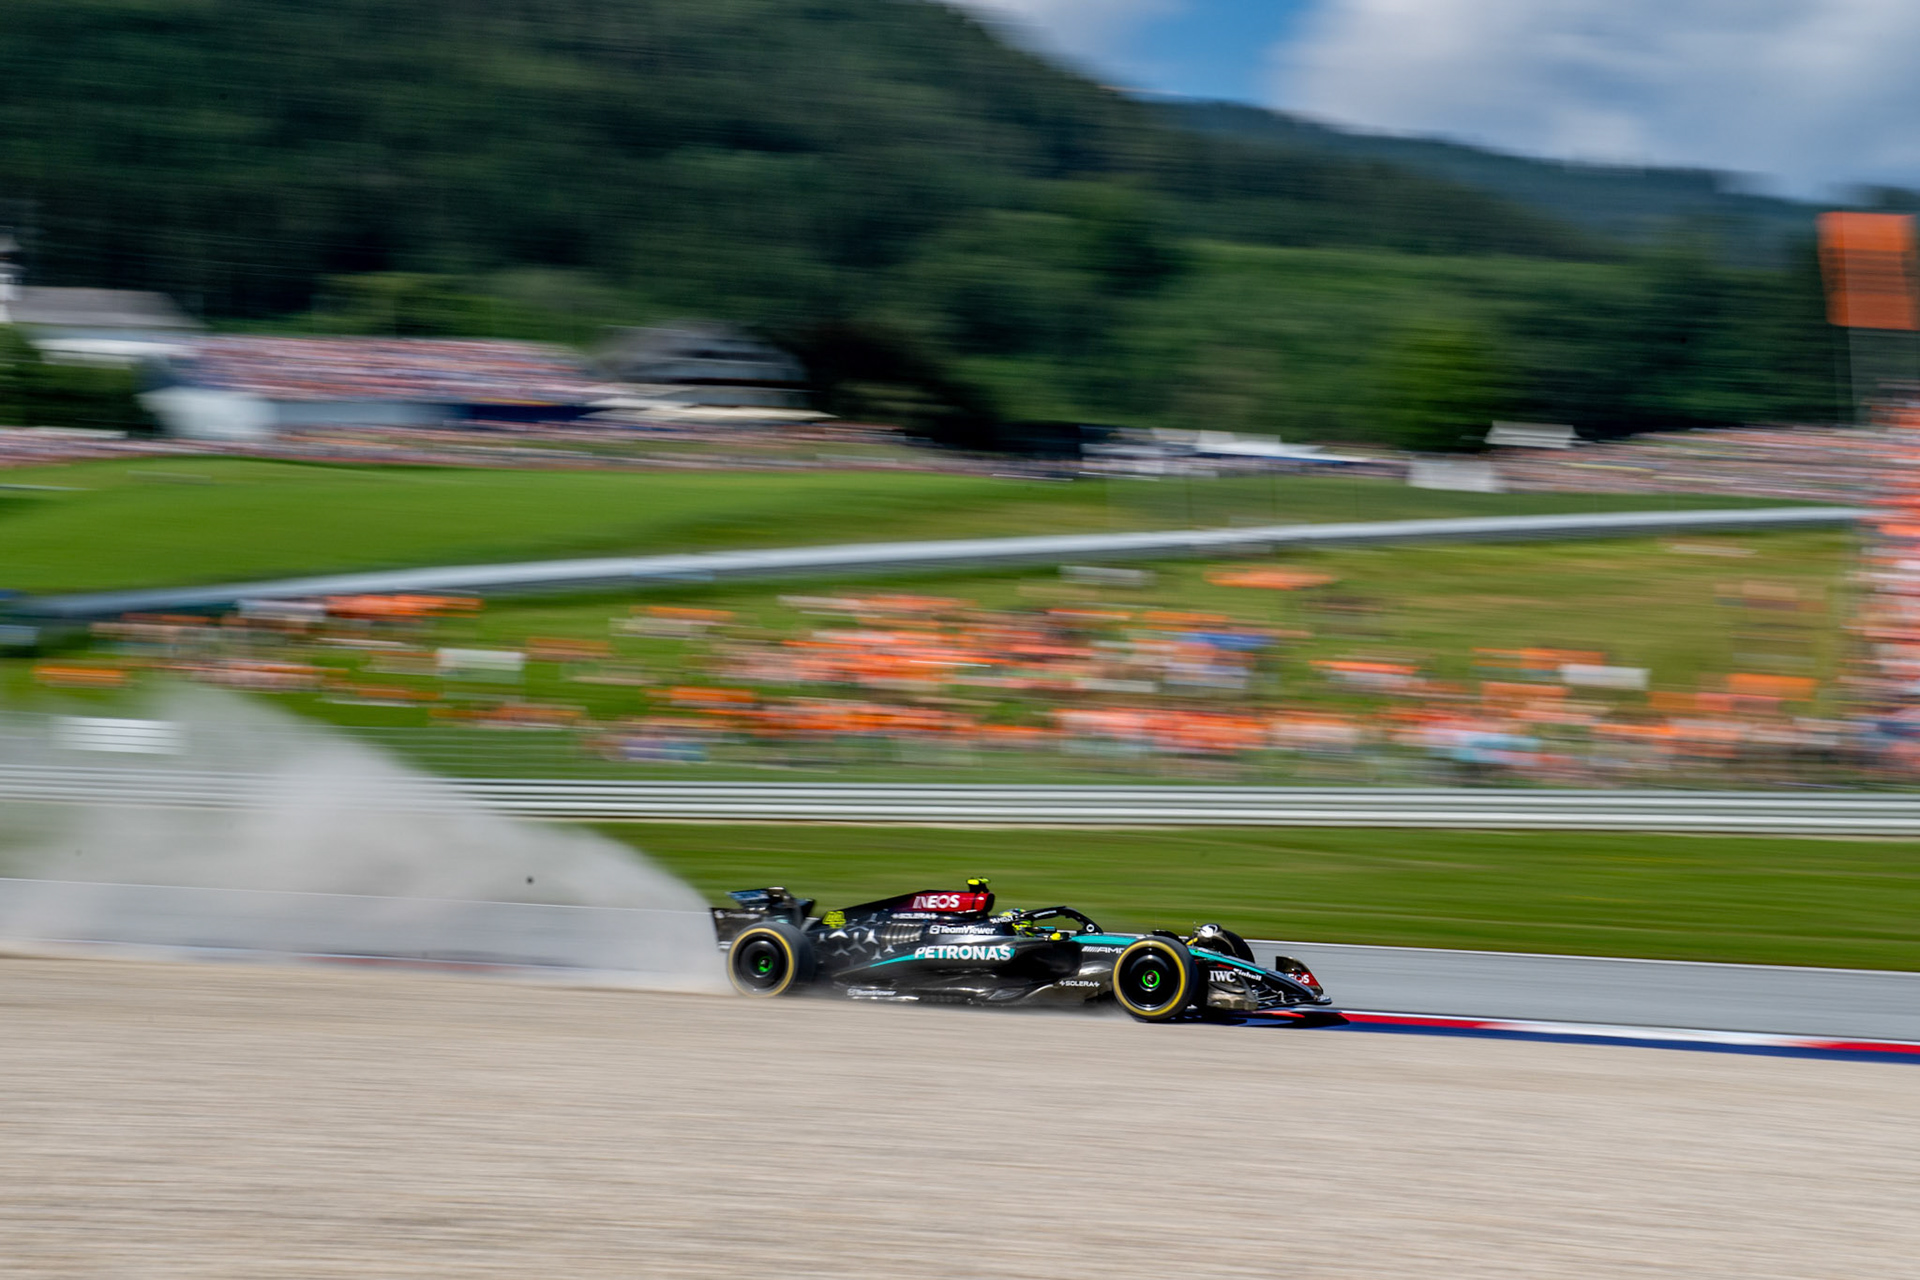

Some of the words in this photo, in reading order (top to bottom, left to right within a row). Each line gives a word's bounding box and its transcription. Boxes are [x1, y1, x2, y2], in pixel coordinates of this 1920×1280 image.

[912, 895, 960, 908] INEOS
[940, 926, 996, 934] TeamViewer
[914, 945, 1012, 961] PETRONAS
[1209, 970, 1237, 982] IWC
